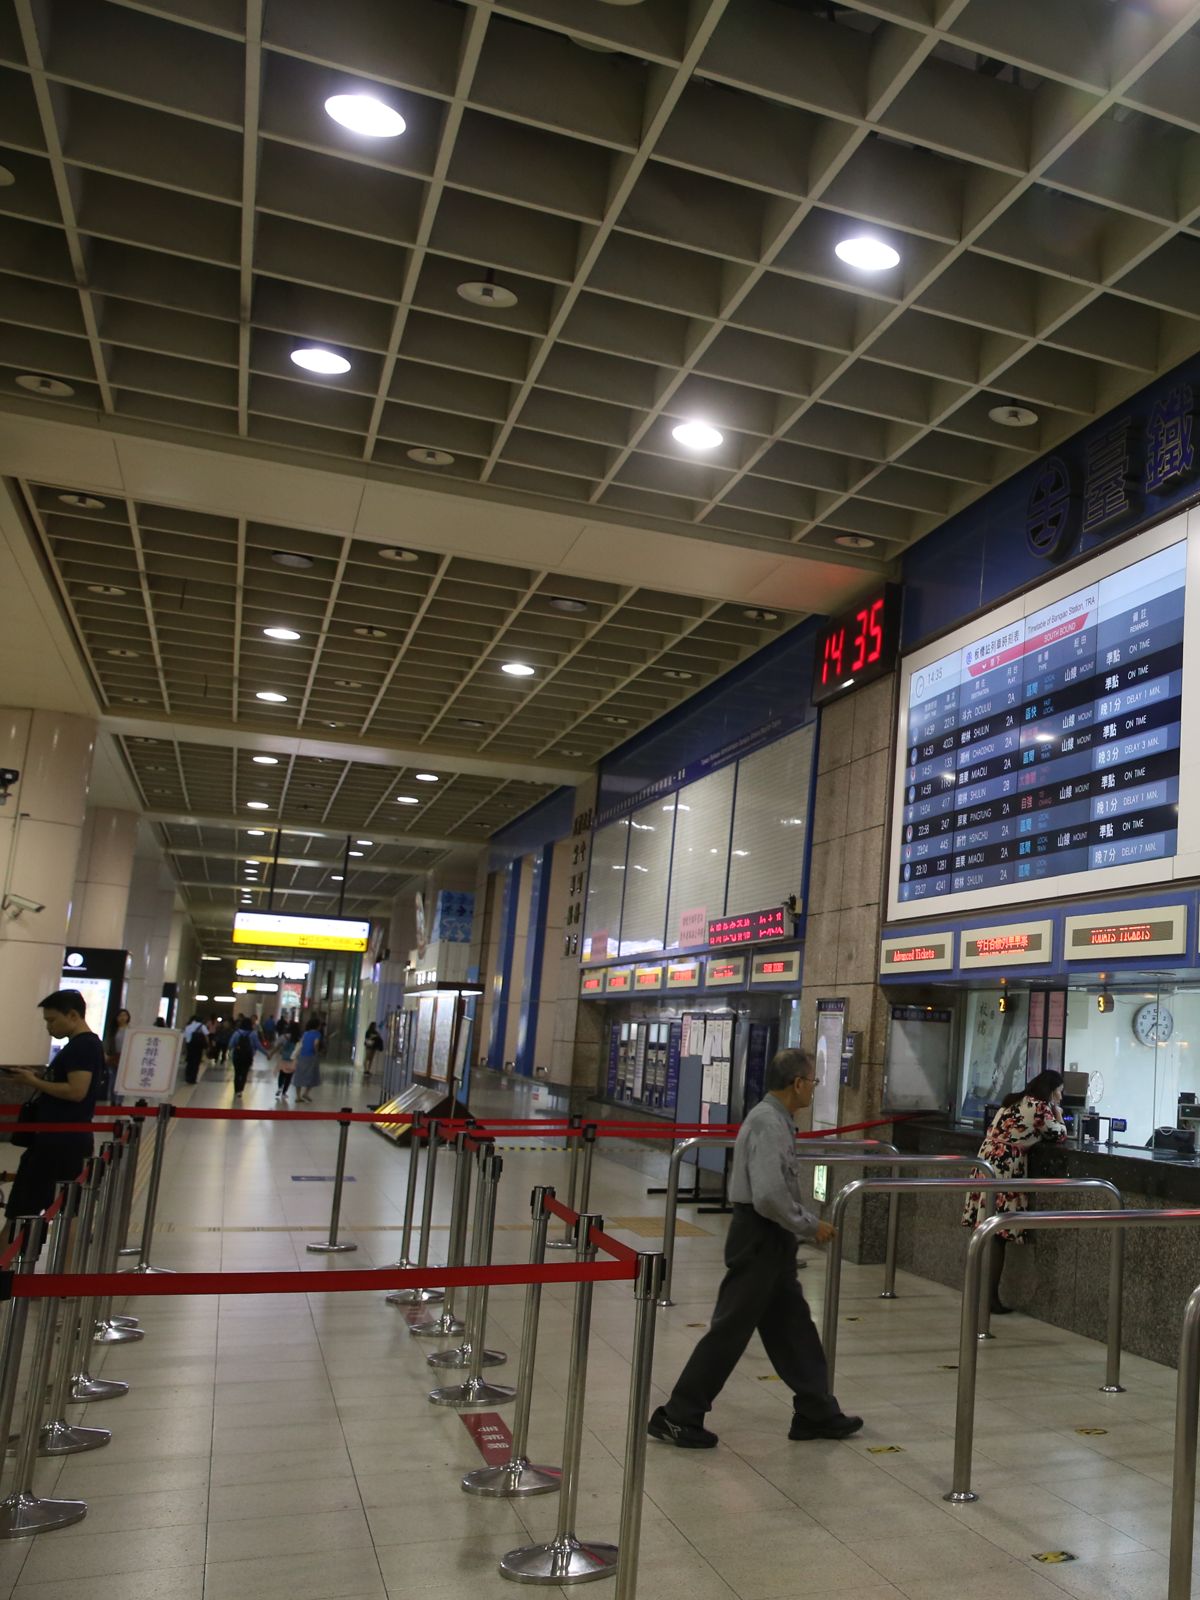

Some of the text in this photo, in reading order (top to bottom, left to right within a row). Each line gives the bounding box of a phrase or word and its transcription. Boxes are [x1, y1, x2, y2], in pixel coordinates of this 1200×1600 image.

[1106, 639, 1150, 665] 準點 ON TIME
[1105, 665, 1149, 691] 準點 ON TIME
[1127, 692, 1141, 705] DELAY
[1150, 686, 1160, 695] MIN.
[915, 948, 935, 959] Tickets
[1000, 999, 1004, 1011] 2
[1098, 997, 1104, 1011] 3
